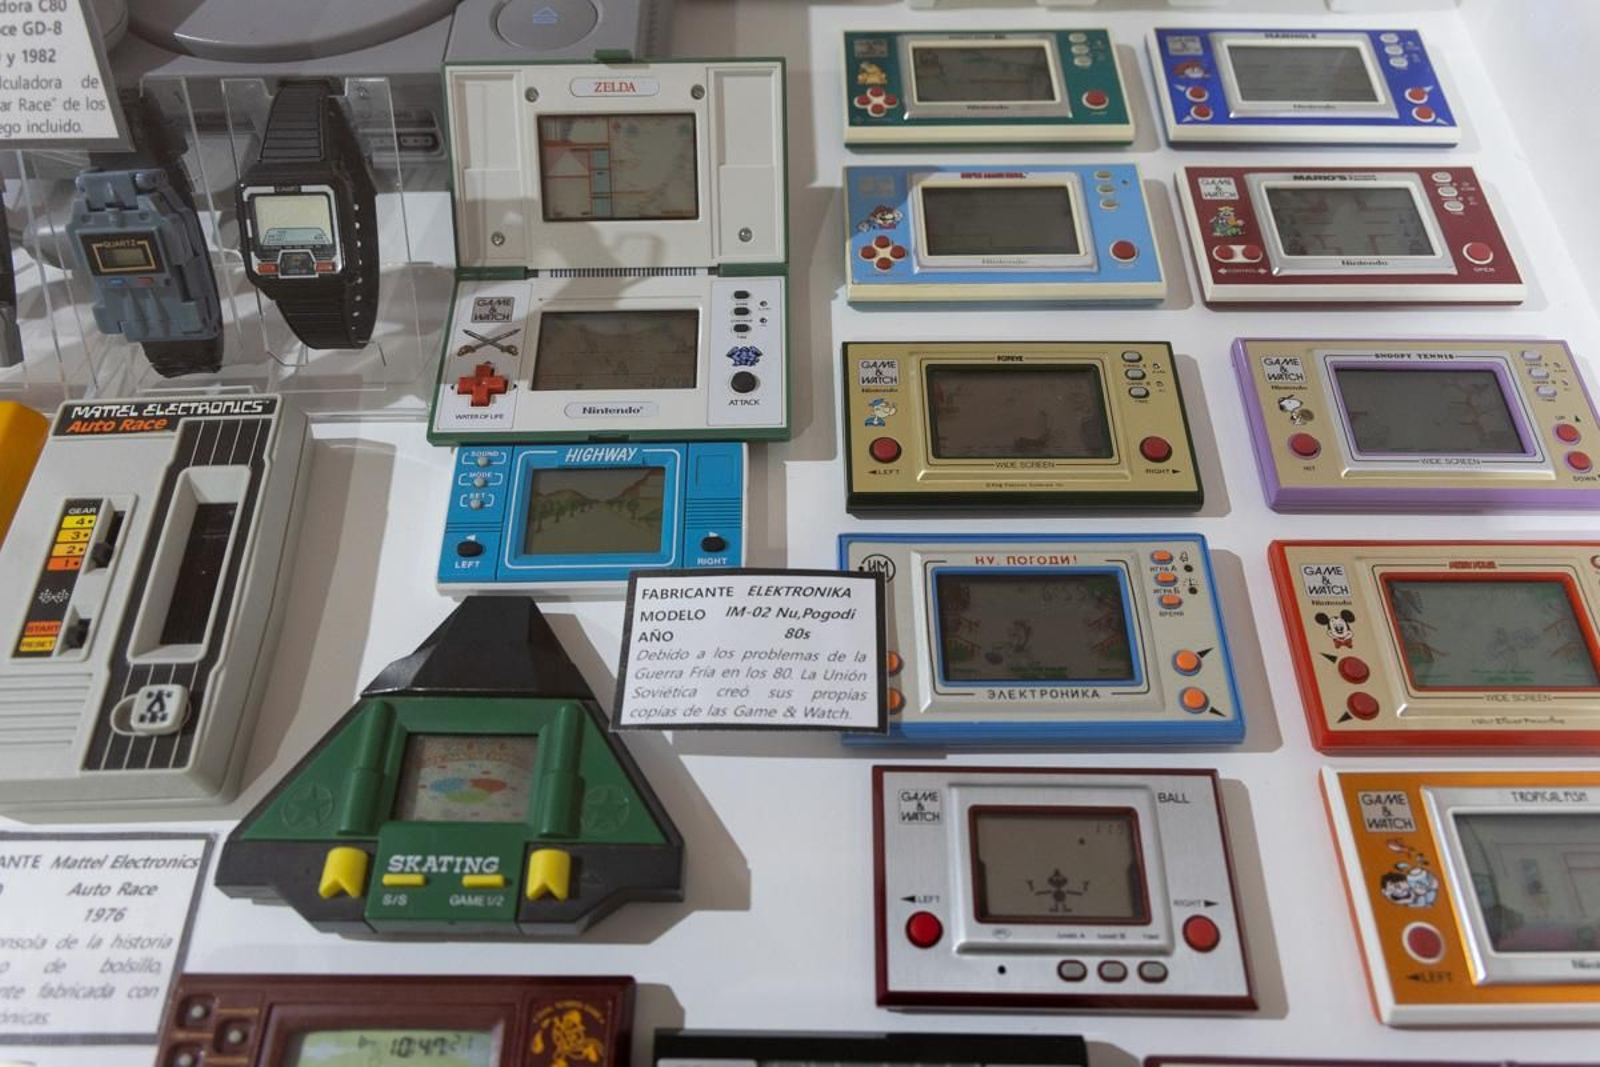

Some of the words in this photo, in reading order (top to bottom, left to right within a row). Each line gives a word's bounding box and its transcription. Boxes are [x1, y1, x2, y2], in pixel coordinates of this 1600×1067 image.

[38, 0, 67, 13] C80
[22, 20, 62, 36] GD-8
[6, 53, 15, 68] y
[22, 48, 56, 63] 1982
[81, 75, 99, 89] de
[594, 81, 636, 93] ZELDA
[63, 97, 80, 111] de
[86, 98, 106, 111] los
[27, 119, 84, 133] incluido.
[1201, 178, 1233, 186] GAME
[1203, 191, 1239, 199] WATCH
[104, 239, 137, 248] QUARTZ
[476, 299, 512, 307] GAME
[473, 313, 511, 321] WATCH
[861, 360, 897, 370] GAME
[1263, 358, 1300, 366] GAME
[861, 375, 898, 385] WATCH
[1267, 373, 1304, 382] WATCH
[728, 398, 760, 406] ATTACK
[71, 404, 139, 419] MATTEL
[582, 405, 641, 415] Nintendo
[65, 419, 115, 433] Auto
[118, 418, 168, 431] Race
[565, 447, 638, 463] HIGHWAY
[995, 460, 1017, 469] WIDE
[1019, 461, 1056, 469] SCREEN
[68, 506, 97, 515] GEAR
[75, 516, 86, 526] 4
[70, 530, 80, 540] 3
[66, 545, 76, 554] 2
[63, 559, 70, 568] 1
[455, 561, 480, 569] LEFT
[697, 557, 728, 565] RIGHT
[1006, 555, 1078, 566] ПОГОДИ!
[1303, 565, 1344, 576] GAME
[1321, 577, 1332, 586] &
[642, 586, 734, 600] FABRICANTE
[747, 585, 852, 599] ELEKTRONIKA
[1307, 584, 1349, 596] WATCH
[640, 609, 706, 622] MODELO
[725, 606, 770, 618] IM-02
[776, 606, 856, 622] Nu,Pogodi
[637, 628, 674, 642] AÑO
[784, 627, 811, 640] 80s
[20, 637, 55, 649] RESET
[636, 649, 690, 661] Debido
[696, 650, 706, 660] a
[713, 647, 735, 659] los
[742, 648, 820, 662] problemas
[827, 650, 847, 662] de
[854, 650, 868, 663] la
[634, 667, 683, 680] Guerra
[720, 668, 741, 678] en
[745, 666, 768, 679] los
[800, 669, 817, 680] La
[823, 669, 868, 681] Unión
[716, 685, 750, 698] creó
[768, 688, 794, 699] sus
[811, 688, 868, 702] propias
[987, 689, 1101, 701] ЭЛЕКТРОНИКА
[629, 705, 678, 721] copias
[682, 704, 703, 718] de
[707, 703, 728, 718] las
[733, 704, 778, 718] Game
[782, 706, 797, 718] &
[900, 791, 939, 802] GAME
[1157, 792, 1191, 803] BALL
[1361, 793, 1406, 805] GAME
[915, 802, 925, 811] &
[1381, 806, 1393, 817] &
[901, 811, 941, 823] WATCH
[1366, 817, 1414, 830] WATCH
[50, 854, 108, 869] Mattel
[110, 854, 200, 869] Electronics
[388, 854, 500, 873] SKATING
[66, 882, 111, 896] Auto
[117, 882, 158, 896] Race
[382, 894, 408, 906] S/S
[449, 894, 485, 907] GAME
[917, 894, 940, 904] LEFT
[84, 908, 127, 922] 1976
[55, 933, 78, 949] de
[86, 933, 103, 949] la
[110, 933, 172, 949] historia
[43, 957, 67, 974] de
[1419, 972, 1453, 982] LEFT
[38, 982, 115, 999] fabricada
[127, 985, 159, 999] con
